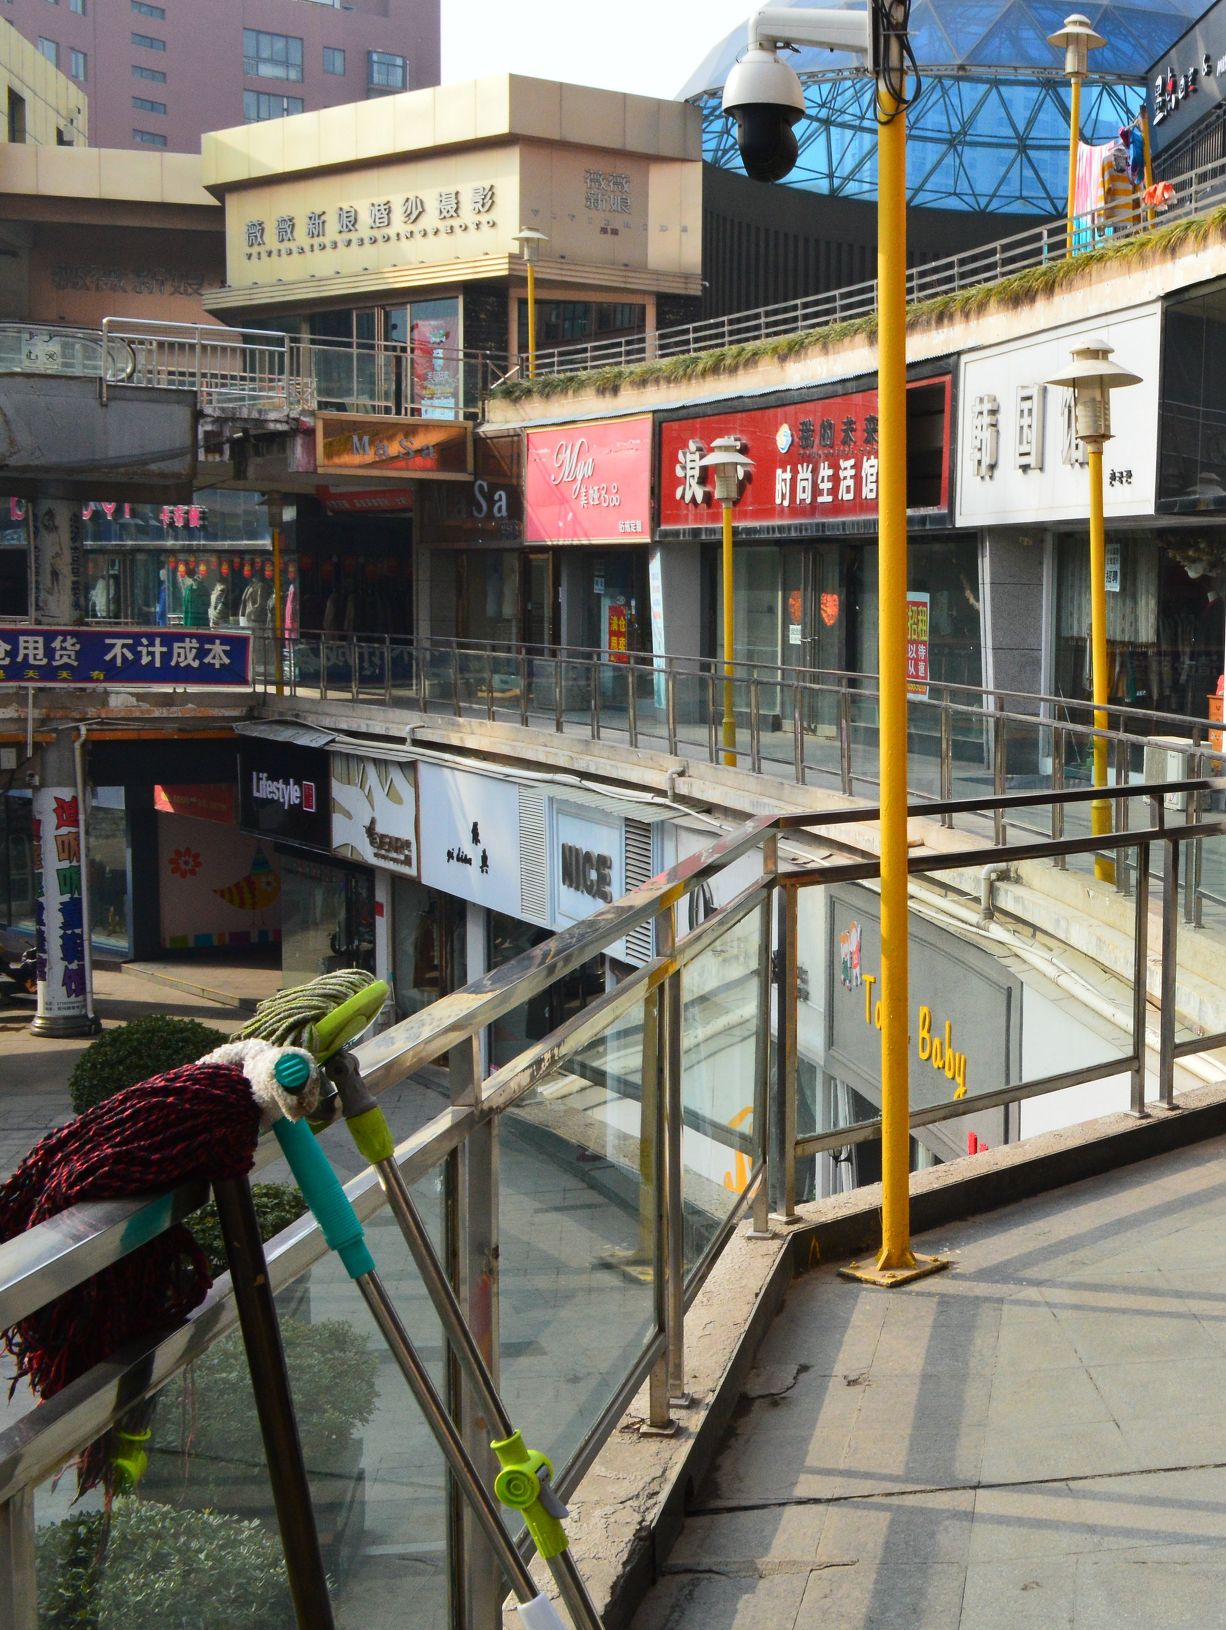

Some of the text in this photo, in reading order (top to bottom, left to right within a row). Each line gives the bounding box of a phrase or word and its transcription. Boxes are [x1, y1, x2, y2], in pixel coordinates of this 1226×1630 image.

[244, 184, 496, 248] 薇薇新娘婚纱摄影
[351, 434, 436, 460] MaSa
[775, 455, 878, 507] 时尚生活馆
[0, 669, 106, 681] 天天有
[104, 637, 231, 669] 不计成本
[252, 771, 300, 809] Lifestyle
[561, 842, 613, 903] NICE
[919, 1005, 968, 1100] Baby
